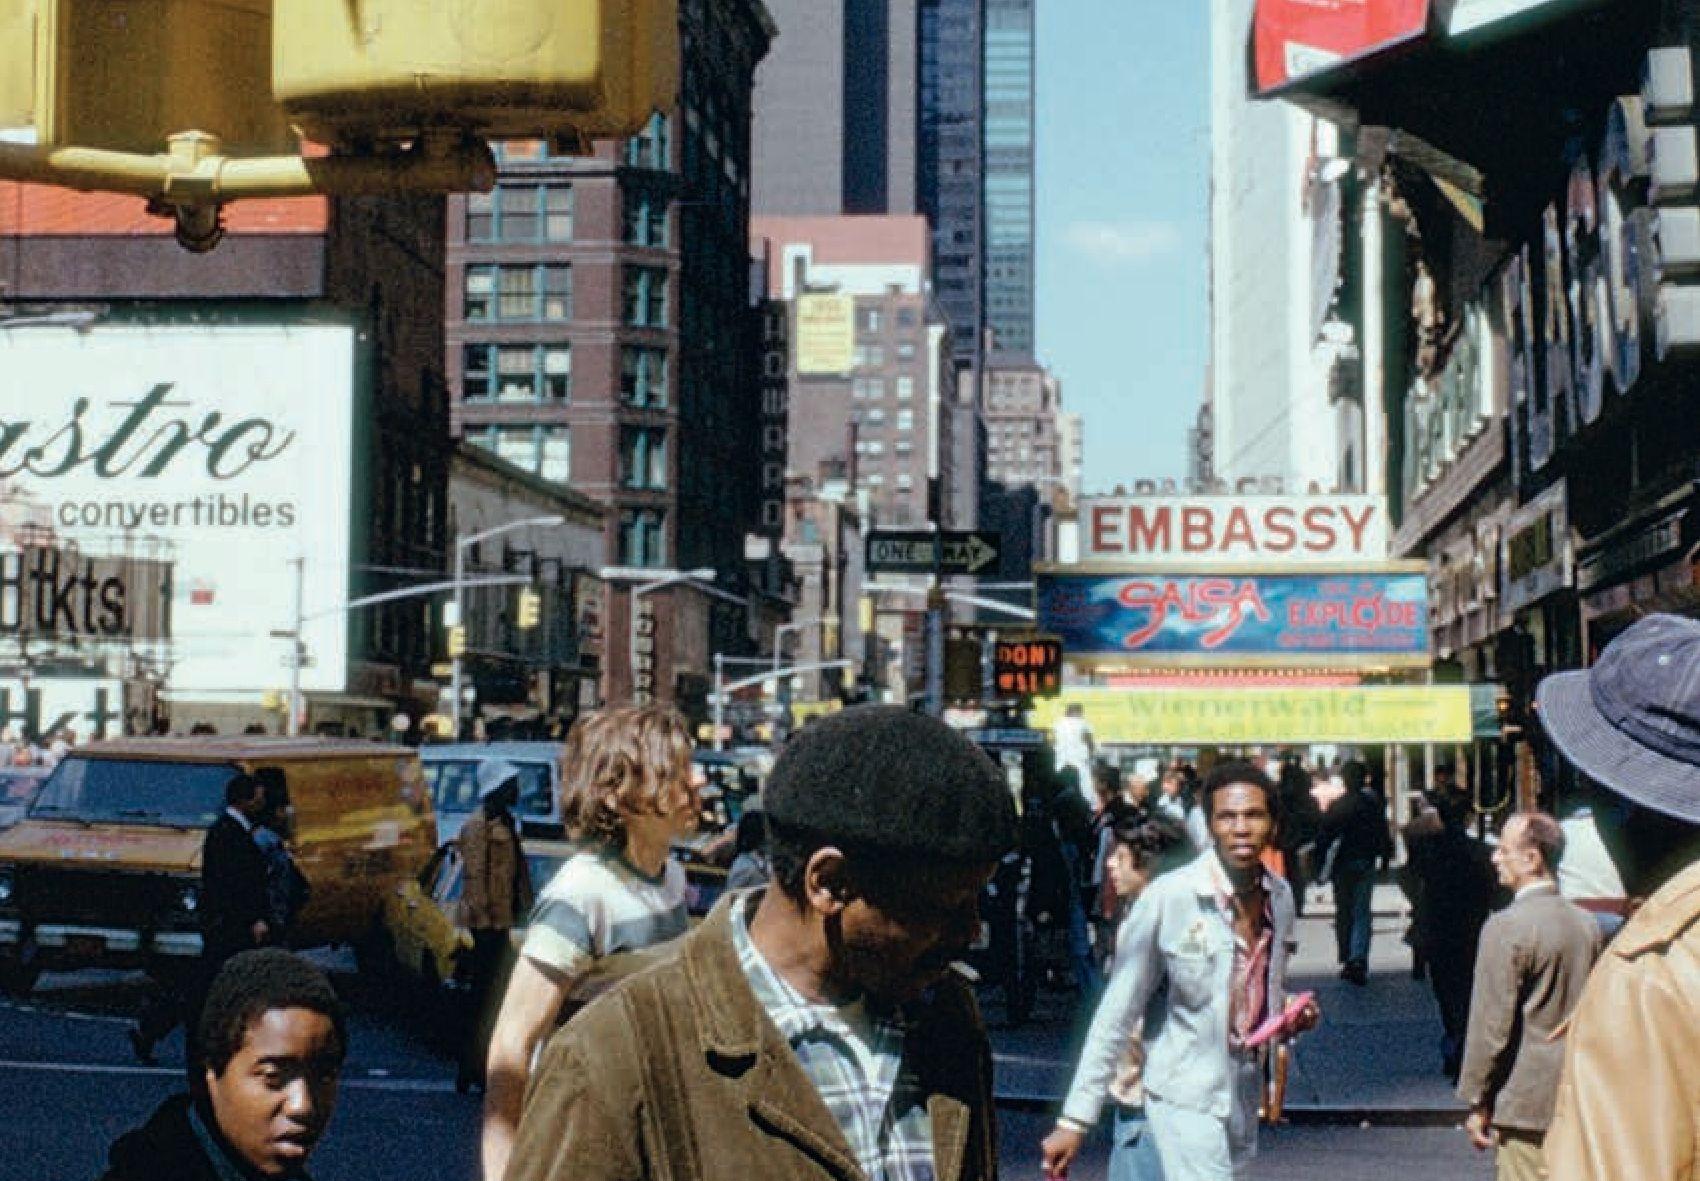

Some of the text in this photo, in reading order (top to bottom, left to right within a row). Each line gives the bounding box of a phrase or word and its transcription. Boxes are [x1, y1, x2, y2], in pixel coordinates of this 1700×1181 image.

[1090, 505, 1376, 553] EMBASSY
[877, 541, 915, 561] ONE
[1118, 580, 1270, 649] SALSA
[1289, 594, 1416, 632] EXPLODE
